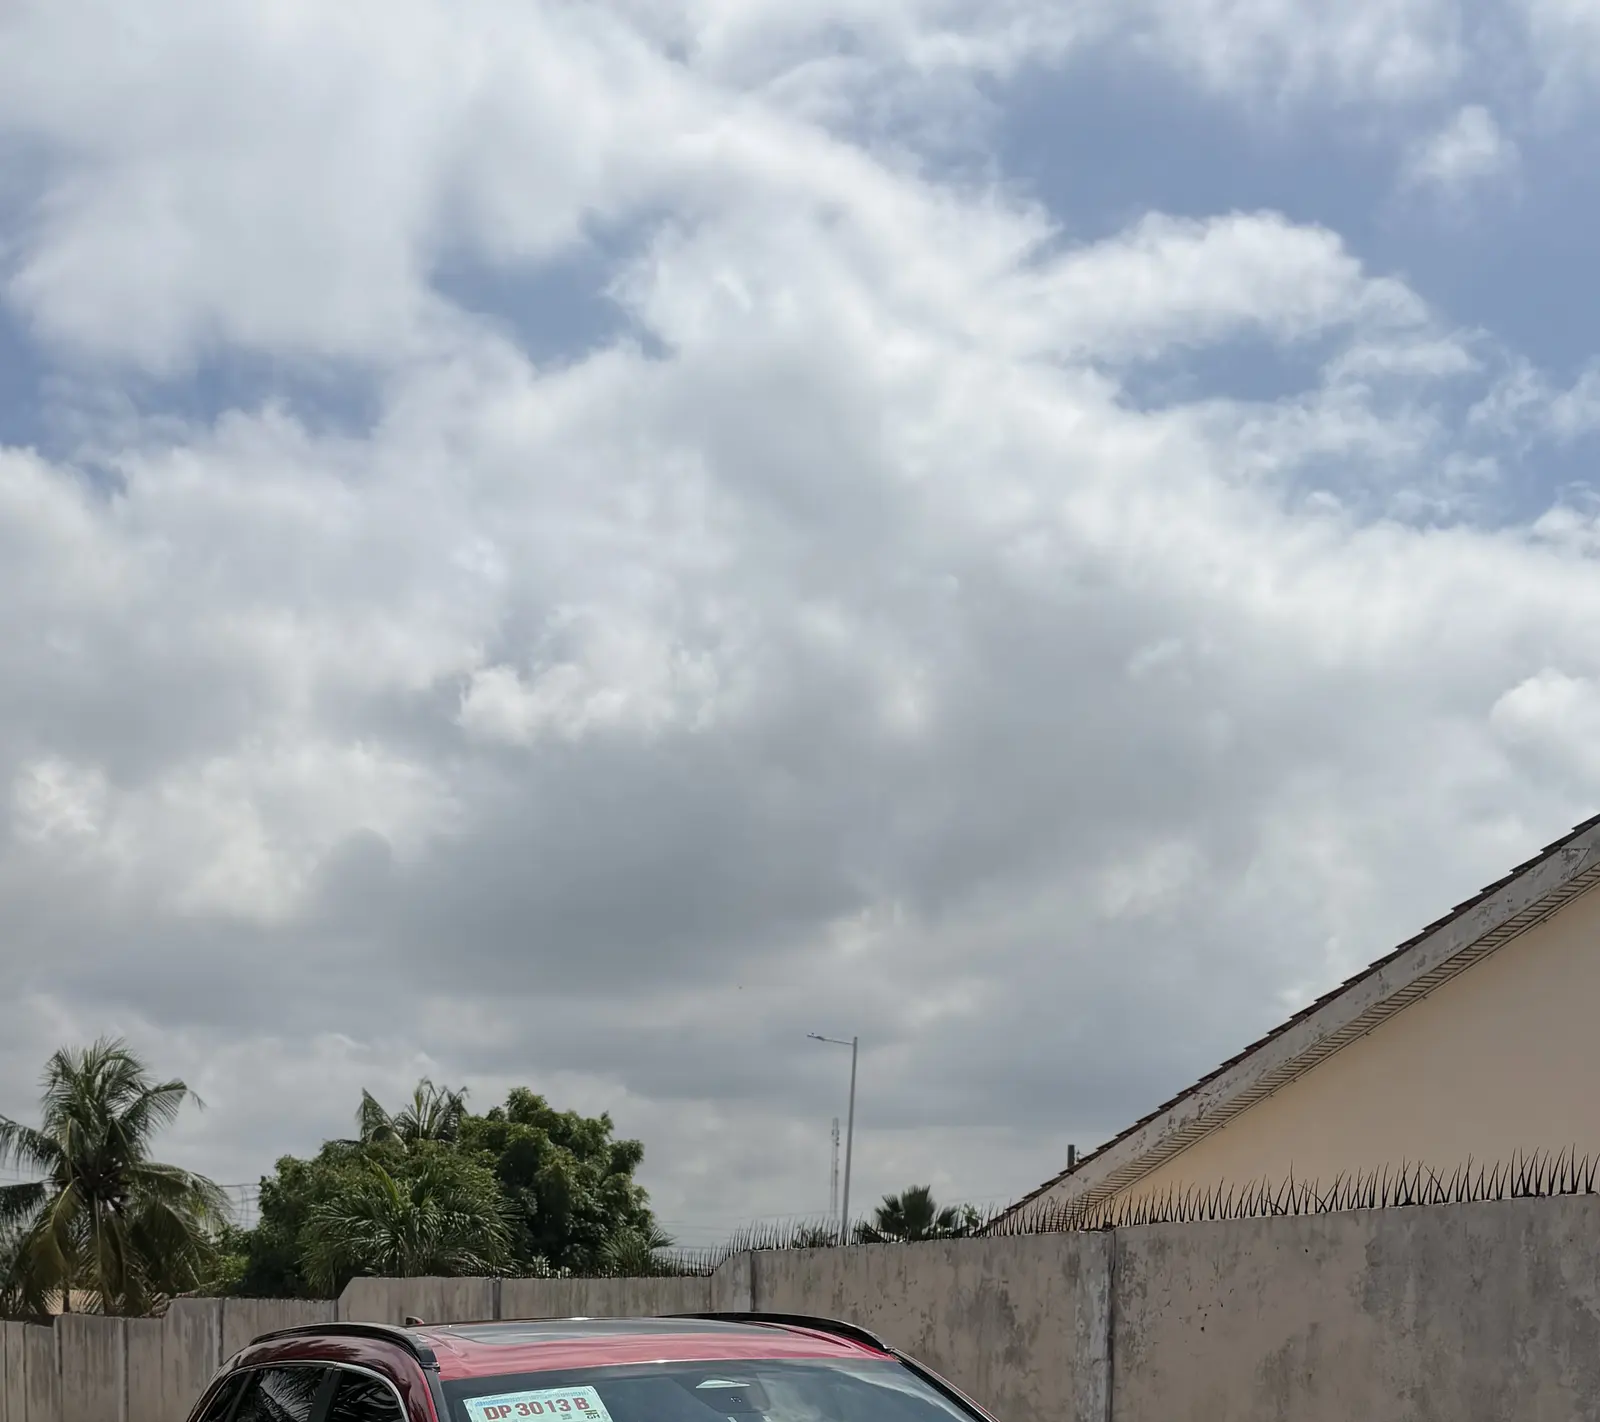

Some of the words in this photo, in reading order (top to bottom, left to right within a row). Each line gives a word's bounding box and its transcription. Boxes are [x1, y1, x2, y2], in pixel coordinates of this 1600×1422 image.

[483, 1404, 512, 1420] DP
[515, 1398, 572, 1417] 3013
[573, 1397, 590, 1411] B
